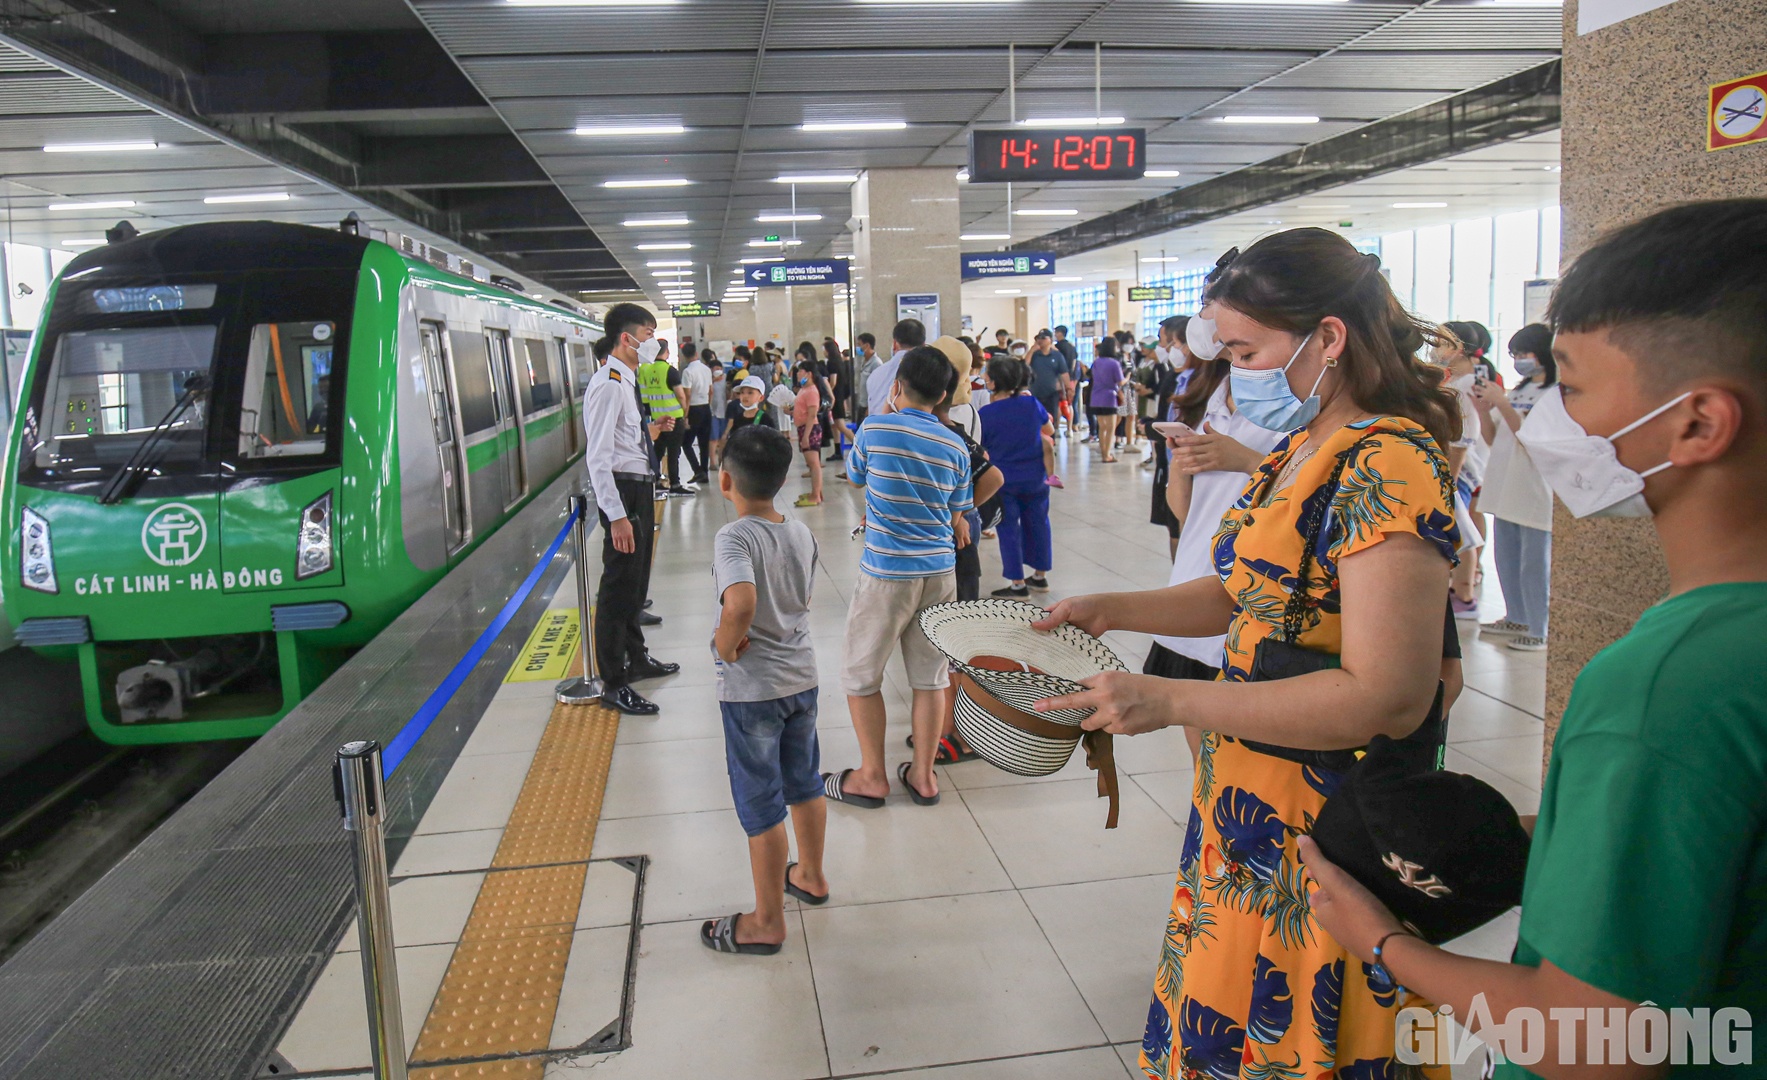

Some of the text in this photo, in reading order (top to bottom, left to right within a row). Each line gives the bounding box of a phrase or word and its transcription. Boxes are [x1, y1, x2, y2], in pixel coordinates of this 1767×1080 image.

[74, 573, 115, 595] CÁT
[122, 574, 170, 593] LINH
[190, 568, 218, 590] HÀ
[222, 566, 283, 589] ĐÔNG
[525, 652, 550, 672] CHÚ
[540, 627, 563, 643] KHE
[563, 633, 575, 643] THE
